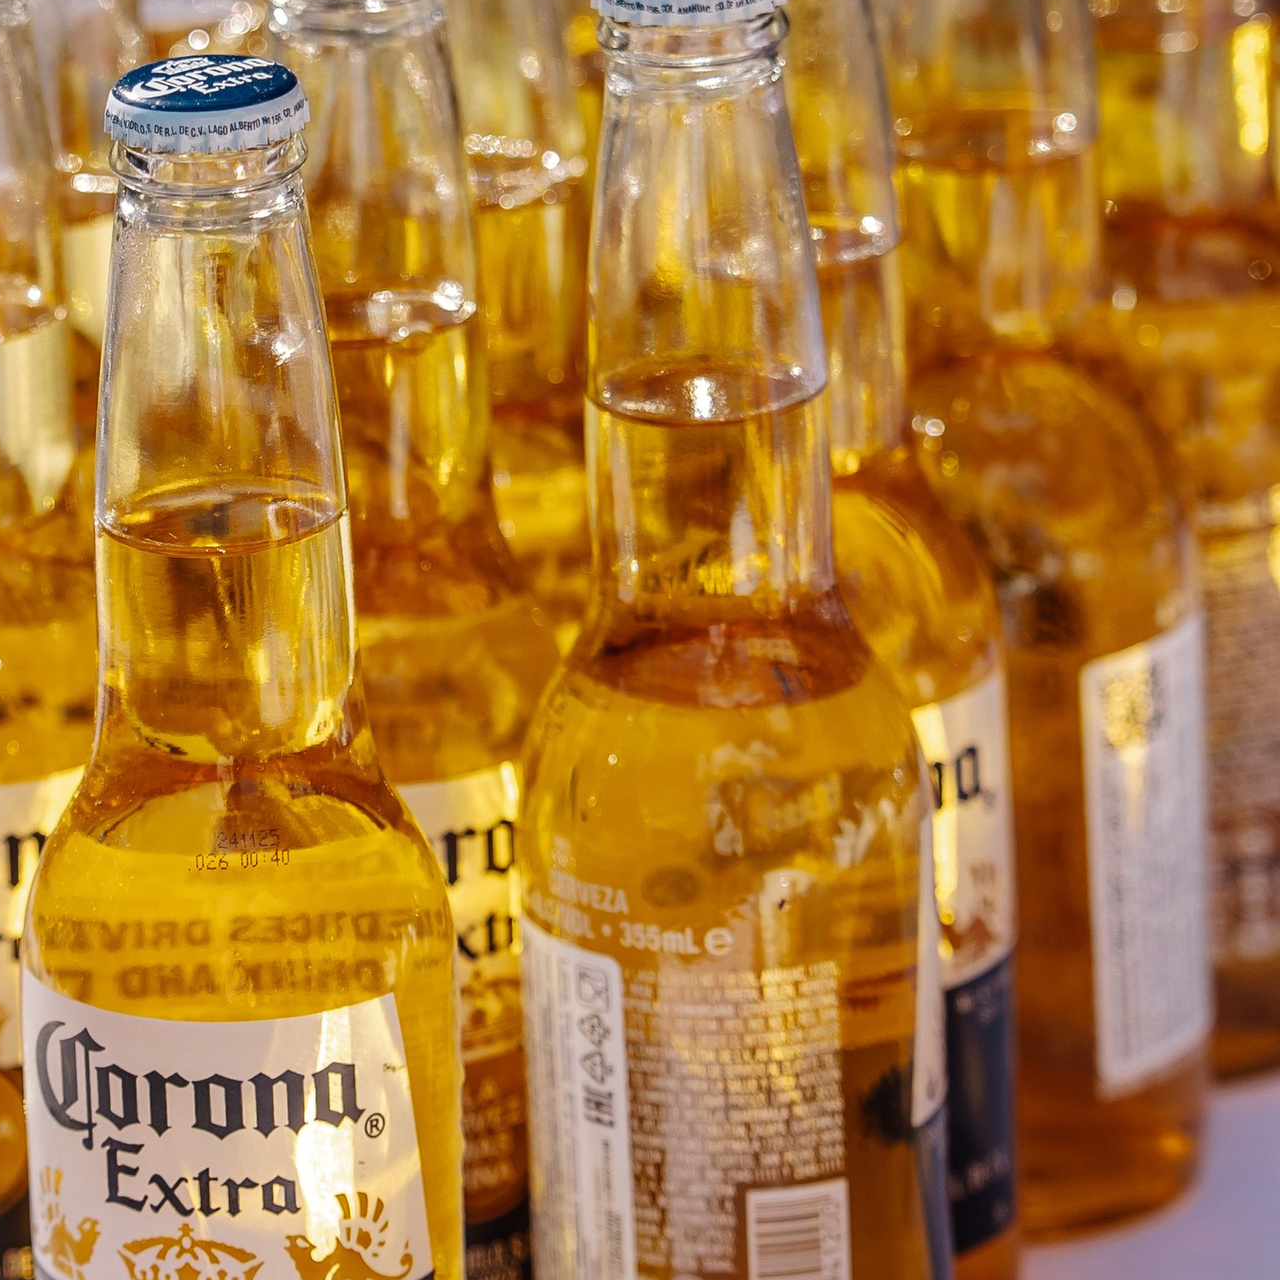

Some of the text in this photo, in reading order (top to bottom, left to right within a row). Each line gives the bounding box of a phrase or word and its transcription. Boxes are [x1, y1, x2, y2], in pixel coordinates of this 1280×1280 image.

[131, 57, 276, 99] Corona
[187, 72, 274, 95] Extra
[154, 124, 163, 136] DE
[178, 124, 189, 136] DE
[207, 124, 228, 136] LAGO
[229, 118, 260, 132] ALBERTO
[217, 827, 279, 849] 241125
[240, 848, 290, 869] 00:40
[36, 1020, 367, 1150] Corona
[101, 1137, 302, 1218] Extra
